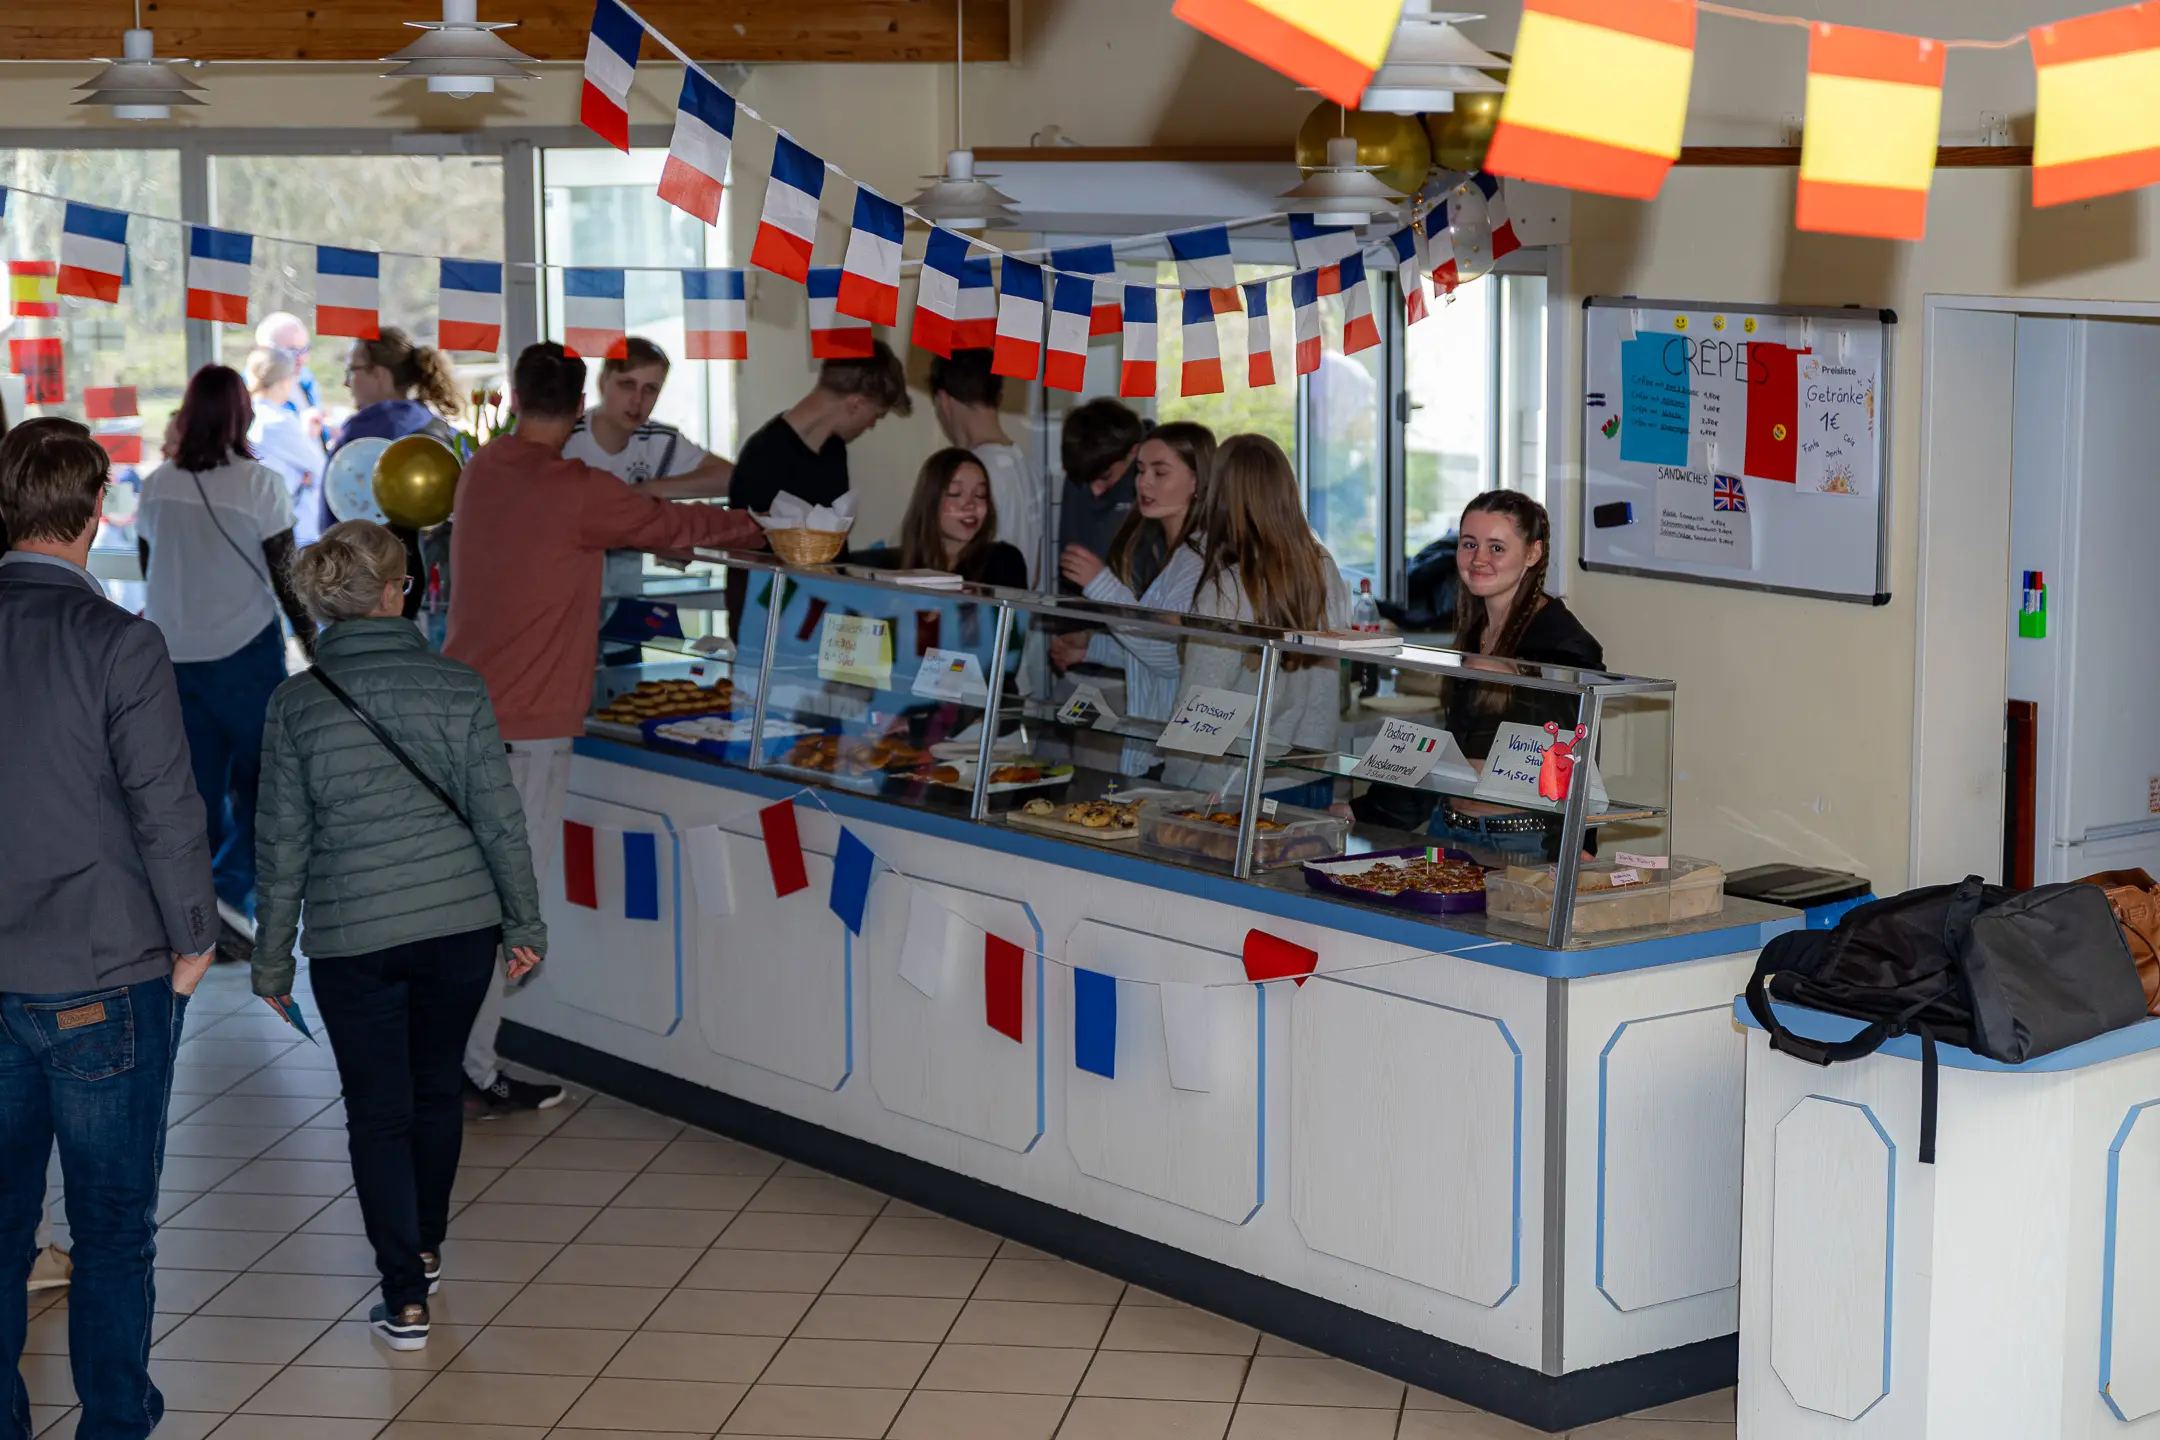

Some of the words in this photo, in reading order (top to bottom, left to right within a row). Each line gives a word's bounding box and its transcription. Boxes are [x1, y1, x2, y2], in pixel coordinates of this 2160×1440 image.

[1663, 337, 1768, 384] CRÊPES
[1822, 366, 1856, 376] Preisliste
[1807, 384, 1864, 405] Getränke
[1820, 411, 1840, 431] 1€
[1658, 466, 1708, 486] SANDWICHES
[1187, 694, 1236, 720] Croissant
[1190, 721, 1222, 735] 1,50€
[1390, 742, 1407, 754] mit
[1508, 733, 1542, 753] Vanille
[1363, 754, 1418, 777] Nusskaramell
[1525, 754, 1543, 767] Sta
[1504, 768, 1536, 784] 1,50€
